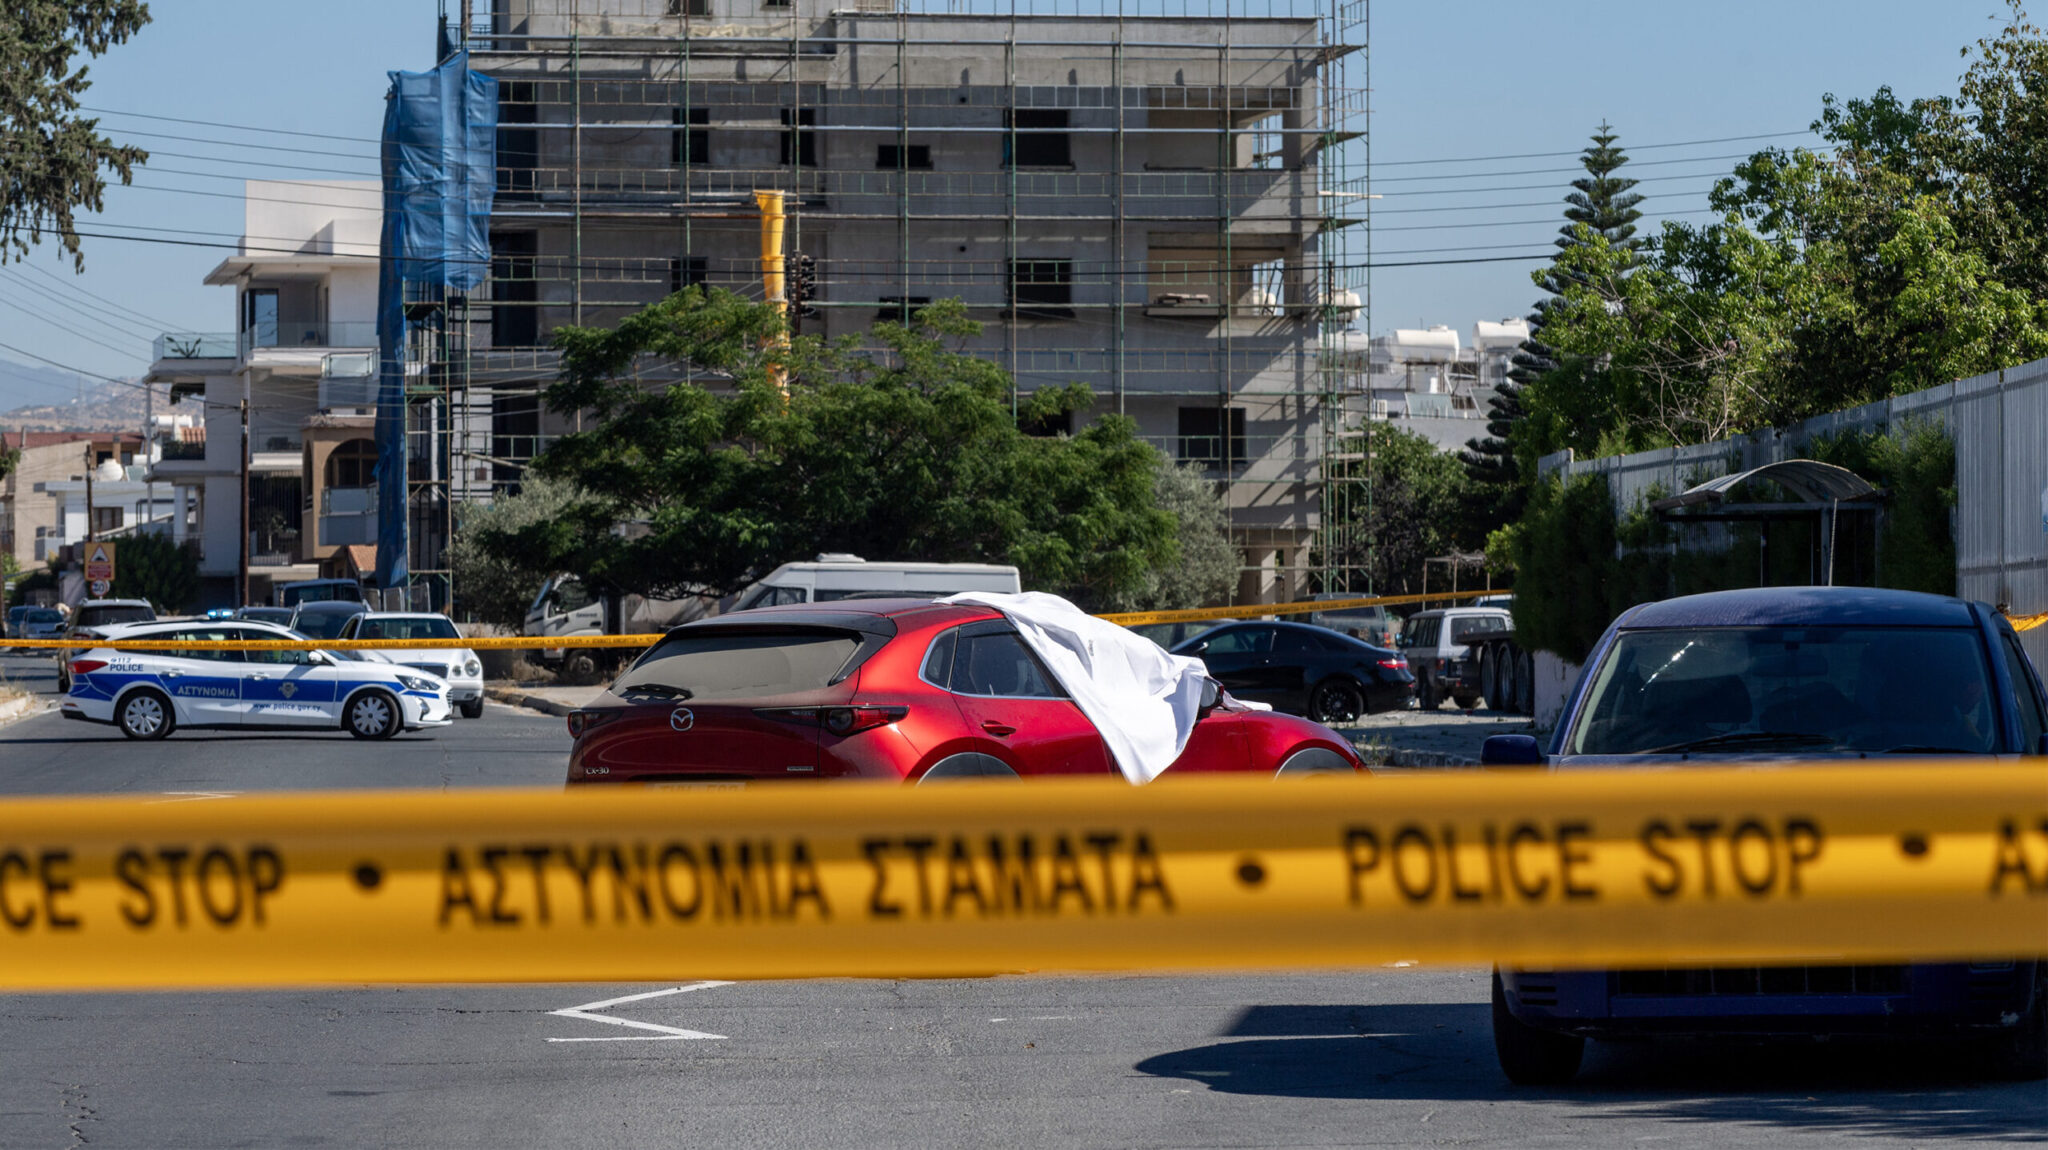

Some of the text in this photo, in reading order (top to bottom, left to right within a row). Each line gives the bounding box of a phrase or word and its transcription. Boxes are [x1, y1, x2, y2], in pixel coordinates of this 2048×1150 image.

[110, 663, 144, 672] POLICE
[177, 685, 237, 698] ΑΣΤΥΝΟΜΙΑ
[586, 766, 610, 775] CX-30
[436, 831, 1176, 928] ΑΣΤΥΝΟΜΙΑ ΣΤΑΜΑΤΑ
[1343, 817, 1826, 905] POLICE STOP
[0, 844, 286, 931] CE STOP
